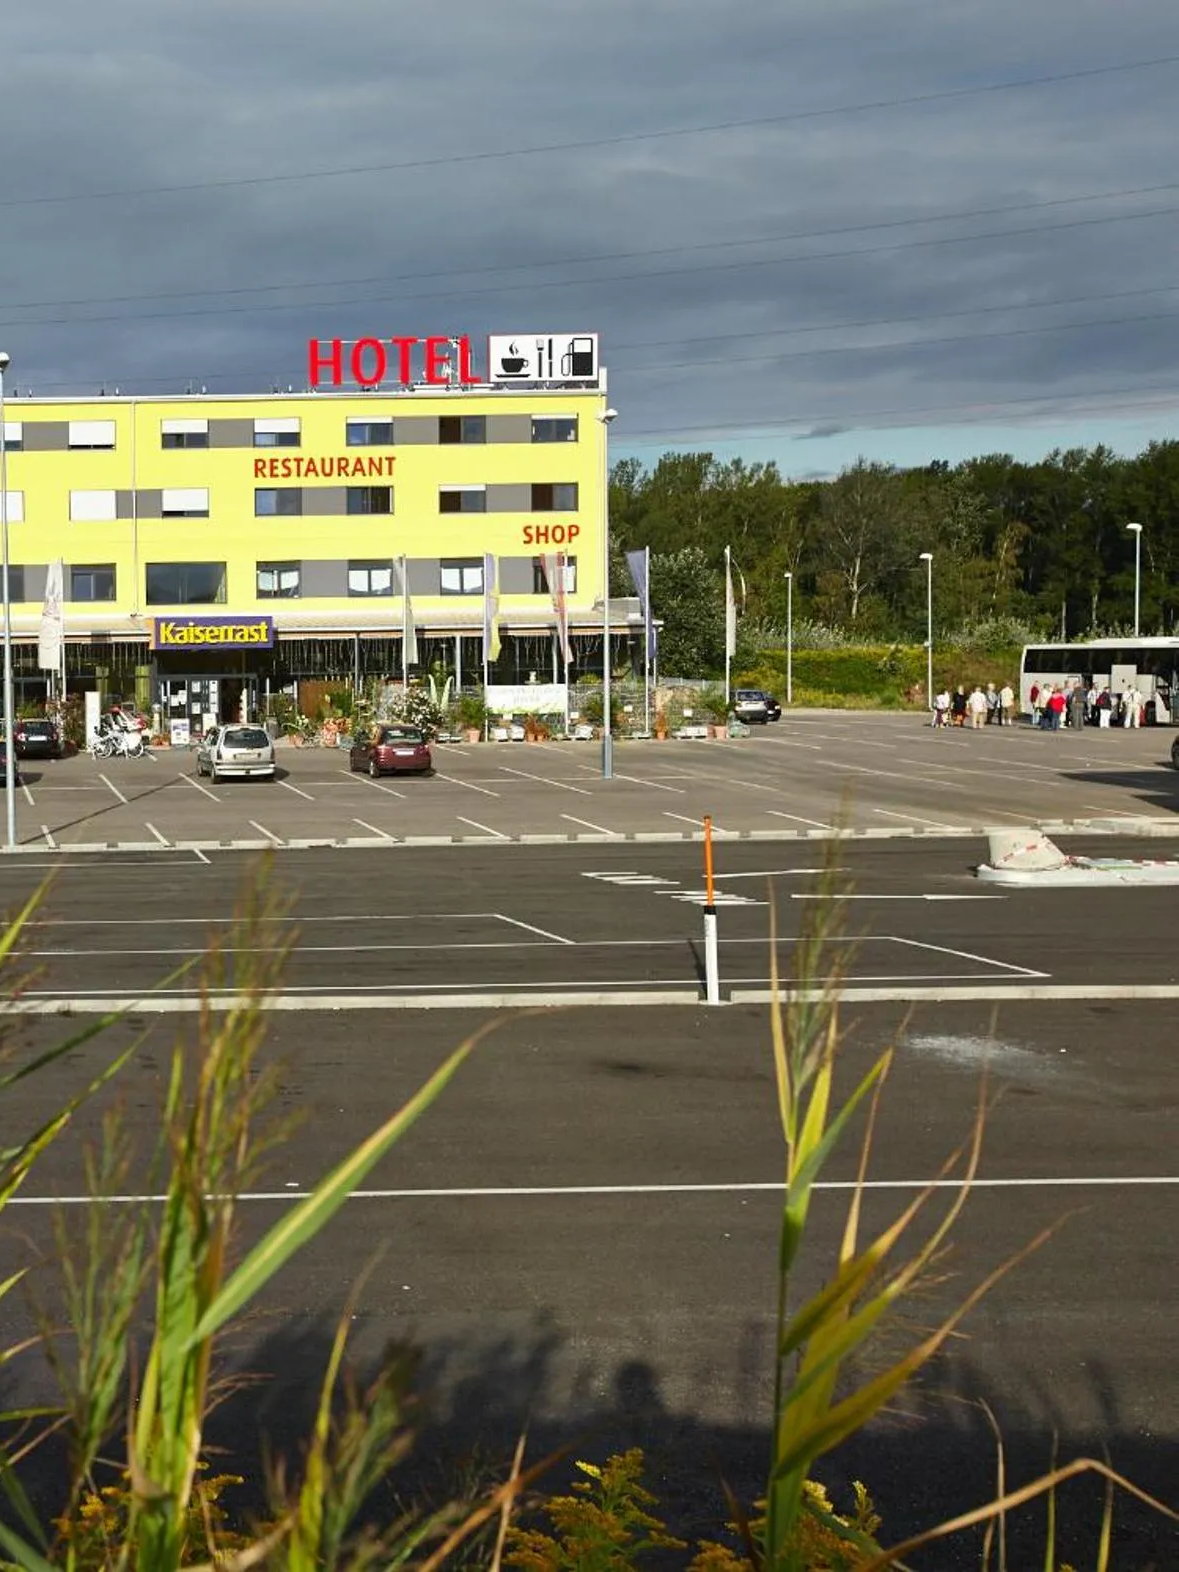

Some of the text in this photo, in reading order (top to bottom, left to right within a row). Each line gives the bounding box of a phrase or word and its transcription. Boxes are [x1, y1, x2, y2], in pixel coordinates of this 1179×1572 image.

[309, 334, 482, 386] HOTEL
[254, 456, 396, 478] RESTAURANT
[523, 524, 580, 544] SHOP
[160, 621, 268, 644] Kaiserrast
